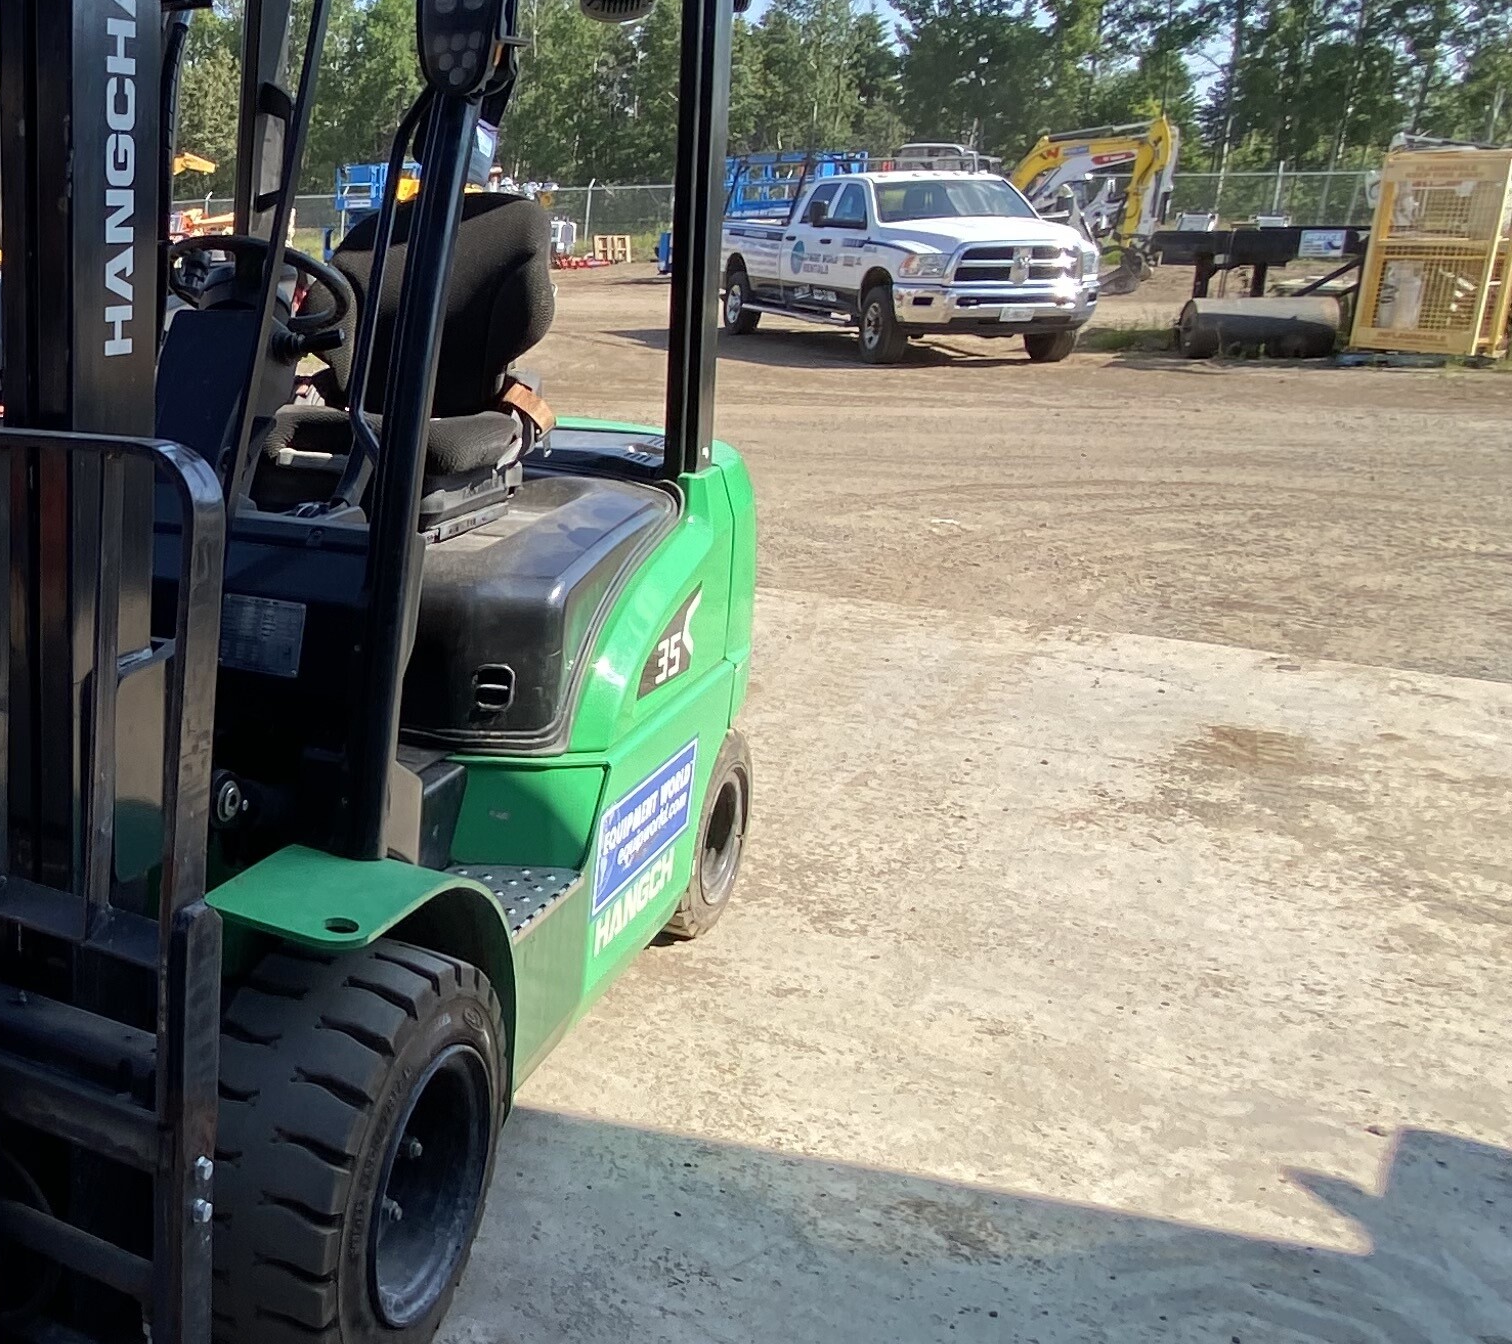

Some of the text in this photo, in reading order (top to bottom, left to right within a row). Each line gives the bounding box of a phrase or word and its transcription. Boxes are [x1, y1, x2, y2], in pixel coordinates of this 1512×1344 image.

[655, 631, 682, 685] 35
[602, 762, 691, 856] EQUIPMENT WORLD
